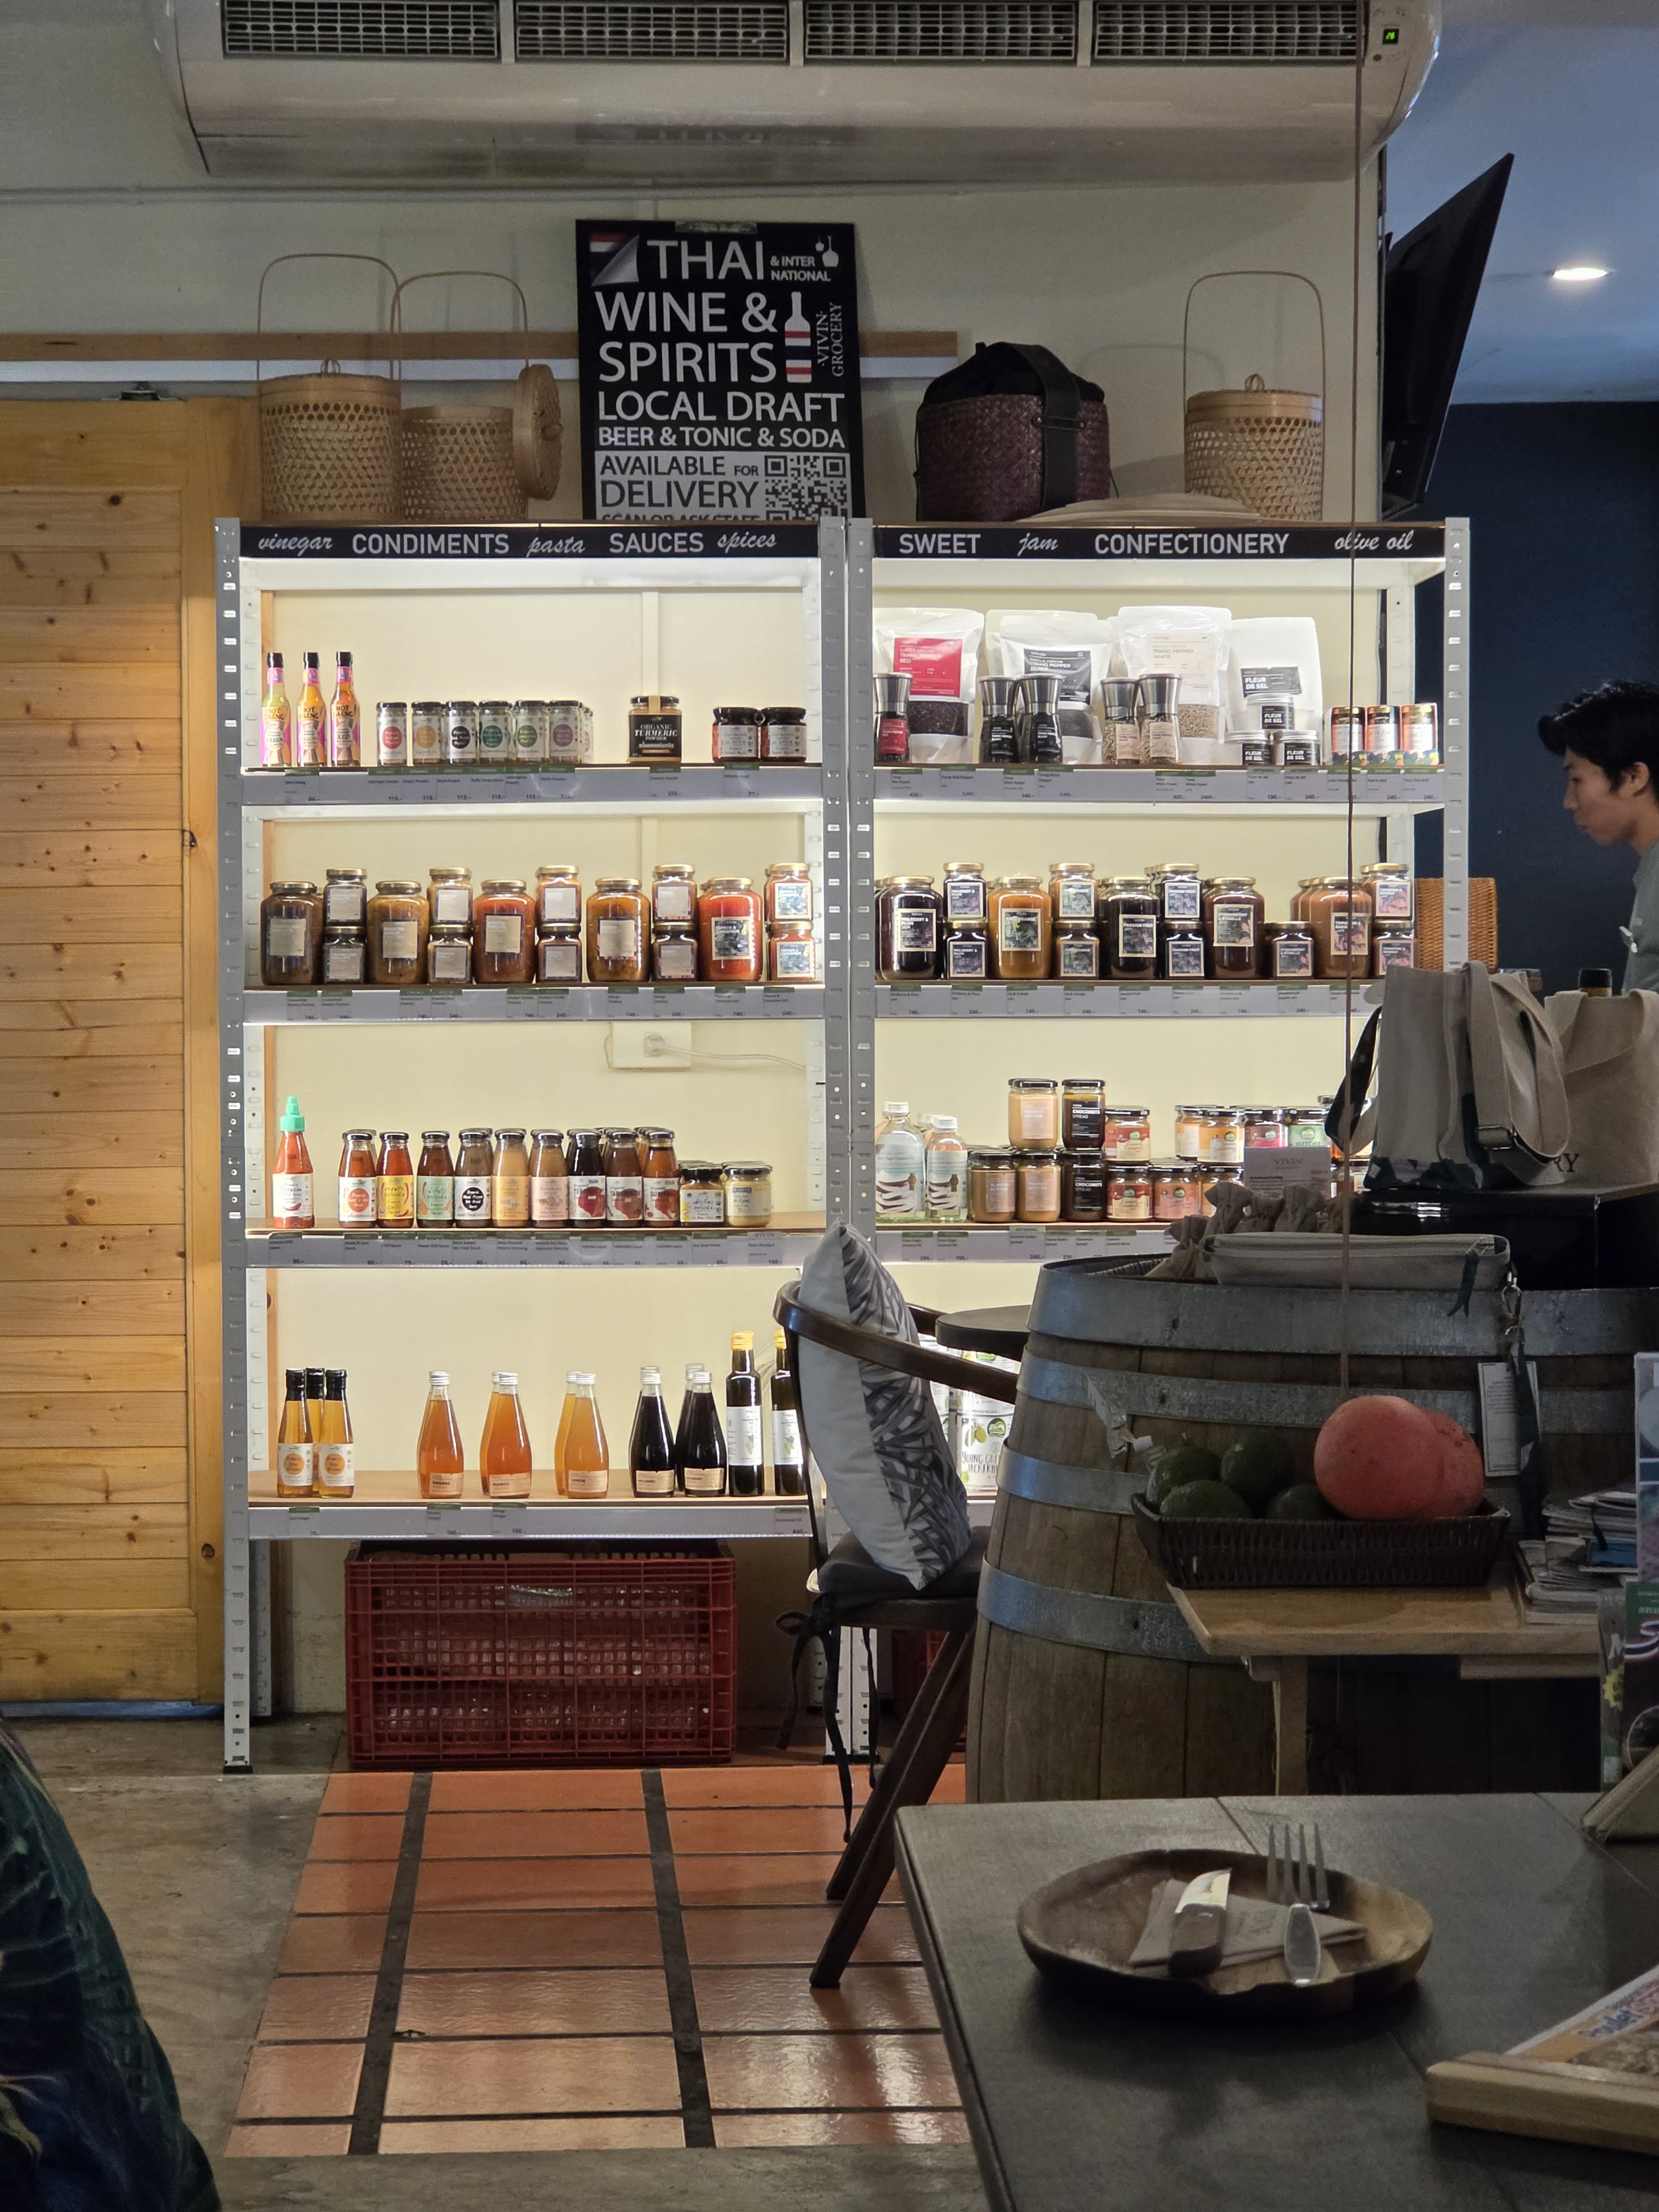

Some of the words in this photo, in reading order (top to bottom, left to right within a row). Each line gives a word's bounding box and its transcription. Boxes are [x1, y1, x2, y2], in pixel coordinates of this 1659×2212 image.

[647, 240, 763, 280] THAI
[770, 256, 780, 266] &
[781, 256, 815, 267] INTER
[771, 271, 831, 282] NATIONAL
[594, 291, 727, 333] WINE
[742, 292, 778, 333] &
[830, 302, 844, 377] GROCERY
[599, 341, 777, 384] SPIRITS
[598, 390, 717, 421] LOCAL
[727, 392, 845, 422] DRAFT
[599, 426, 654, 446] BEER
[660, 427, 677, 447] &
[680, 426, 752, 447] TONIC
[757, 427, 775, 447] &
[779, 428, 846, 449] SODA
[600, 456, 726, 476] AVAILABLE
[734, 465, 759, 477] FOR
[601, 480, 759, 508] DELIVERY
[258, 535, 333, 557] vinegar
[352, 533, 510, 555] CONDIMENTS
[528, 535, 586, 557] pasta
[609, 533, 705, 554] SAUCES
[717, 531, 778, 554] spices
[899, 534, 981, 554] SWEET
[1018, 535, 1059, 557] jam
[1094, 534, 1290, 555] CONFECTIONERY
[1334, 532, 1380, 551] olive
[1386, 530, 1413, 551] oil
[962, 1452, 983, 1464] YOUNG
[985, 1454, 1000, 1464] GRE
[966, 1464, 997, 1474] JACKFRU
